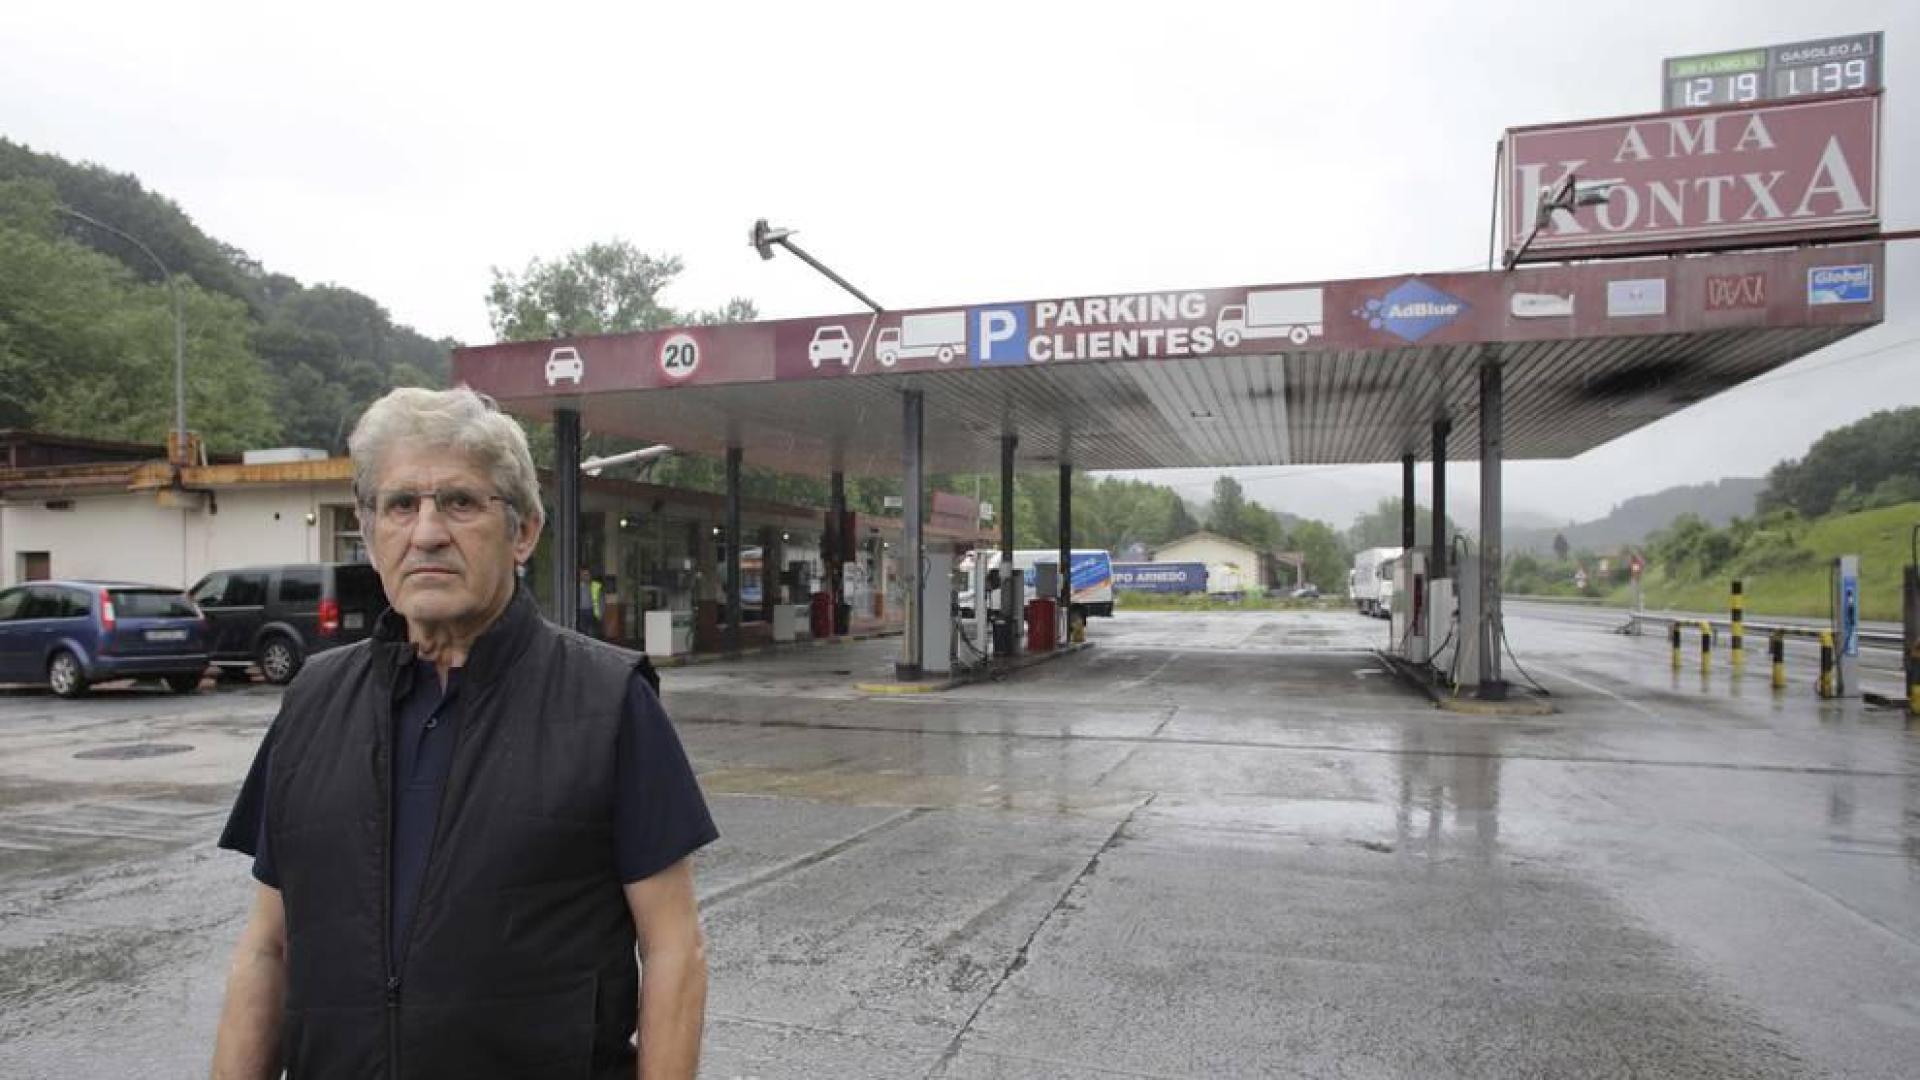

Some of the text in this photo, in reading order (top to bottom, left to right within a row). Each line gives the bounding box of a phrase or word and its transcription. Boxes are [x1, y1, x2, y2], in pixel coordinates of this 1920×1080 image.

[1614, 112, 1777, 162] AMA
[1517, 134, 1872, 236] KONTXA
[1034, 292, 1207, 329] PARKING
[1389, 302, 1459, 319] AdBlue
[979, 310, 1017, 360] P
[1028, 325, 1215, 362] CLIENTES
[664, 344, 696, 368] 20
